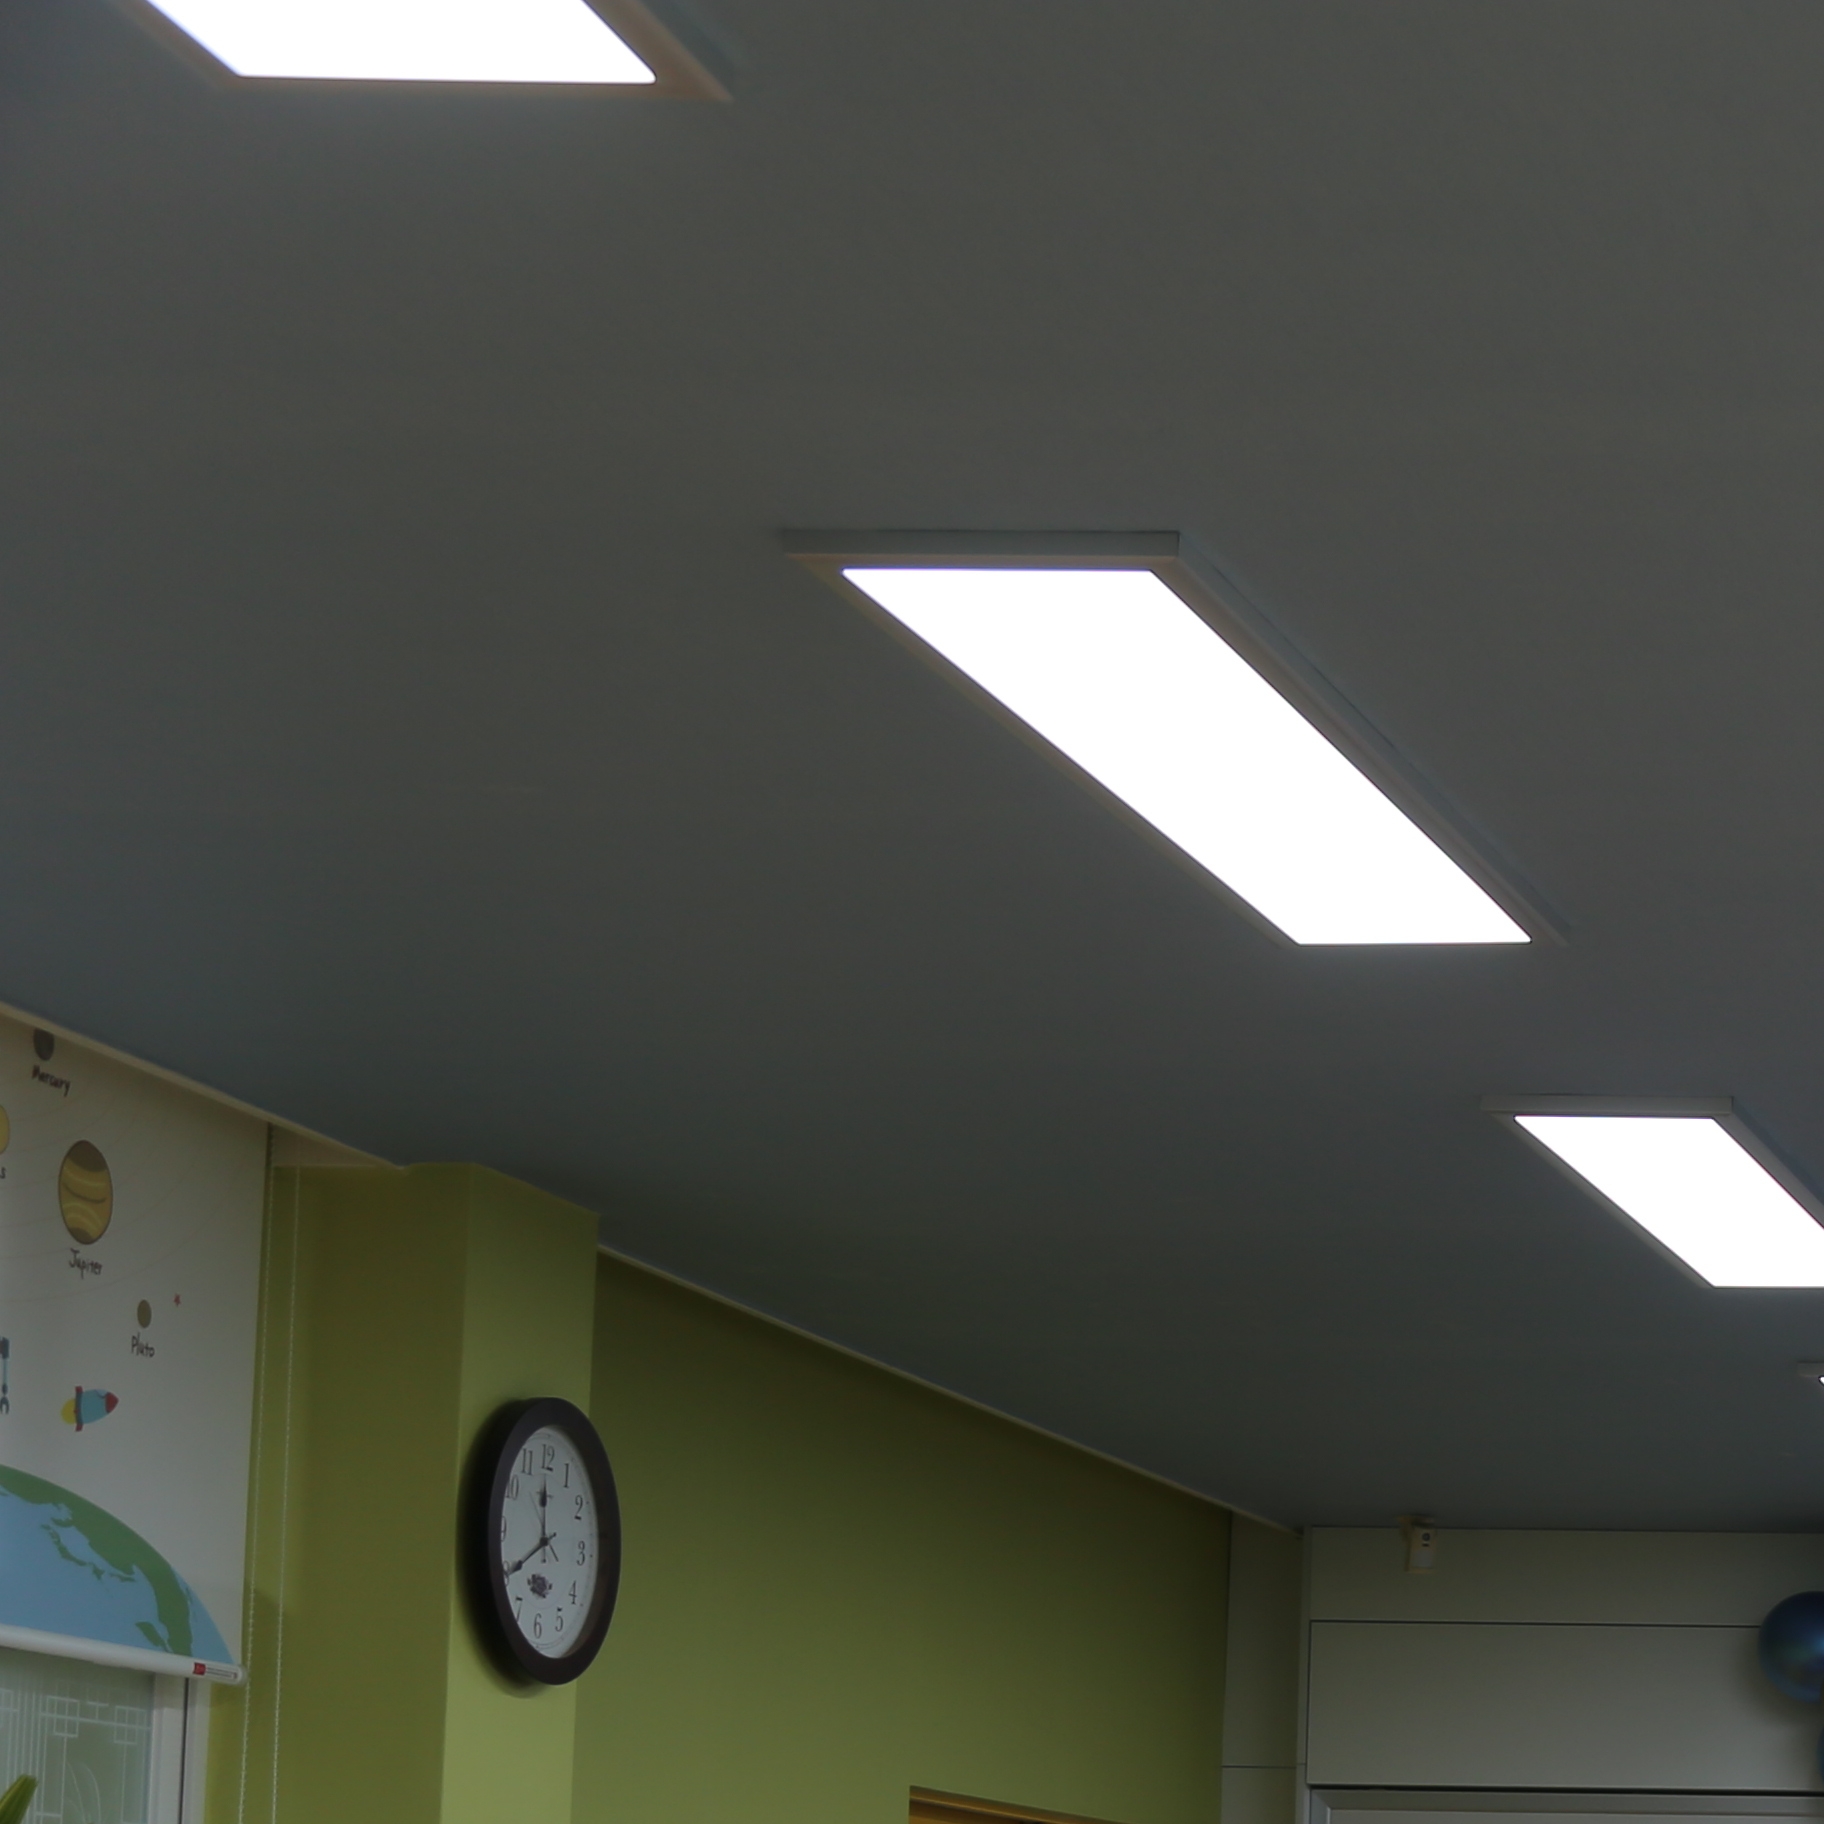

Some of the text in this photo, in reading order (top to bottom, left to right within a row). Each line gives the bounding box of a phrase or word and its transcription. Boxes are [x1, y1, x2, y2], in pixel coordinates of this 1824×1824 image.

[32, 1064, 71, 1097] Mercury
[69, 1248, 103, 1279] Jupiter
[131, 1332, 155, 1358] Pluto
[521, 1449, 533, 1475] 11
[541, 1444, 555, 1472] 12
[506, 1475, 519, 1500] 10
[564, 1463, 570, 1488] 1
[574, 1495, 583, 1520] 2
[577, 1541, 586, 1566] 3
[568, 1580, 577, 1605] 4
[515, 1596, 523, 1623] 7
[555, 1607, 563, 1632] 5
[533, 1613, 542, 1639] 6
